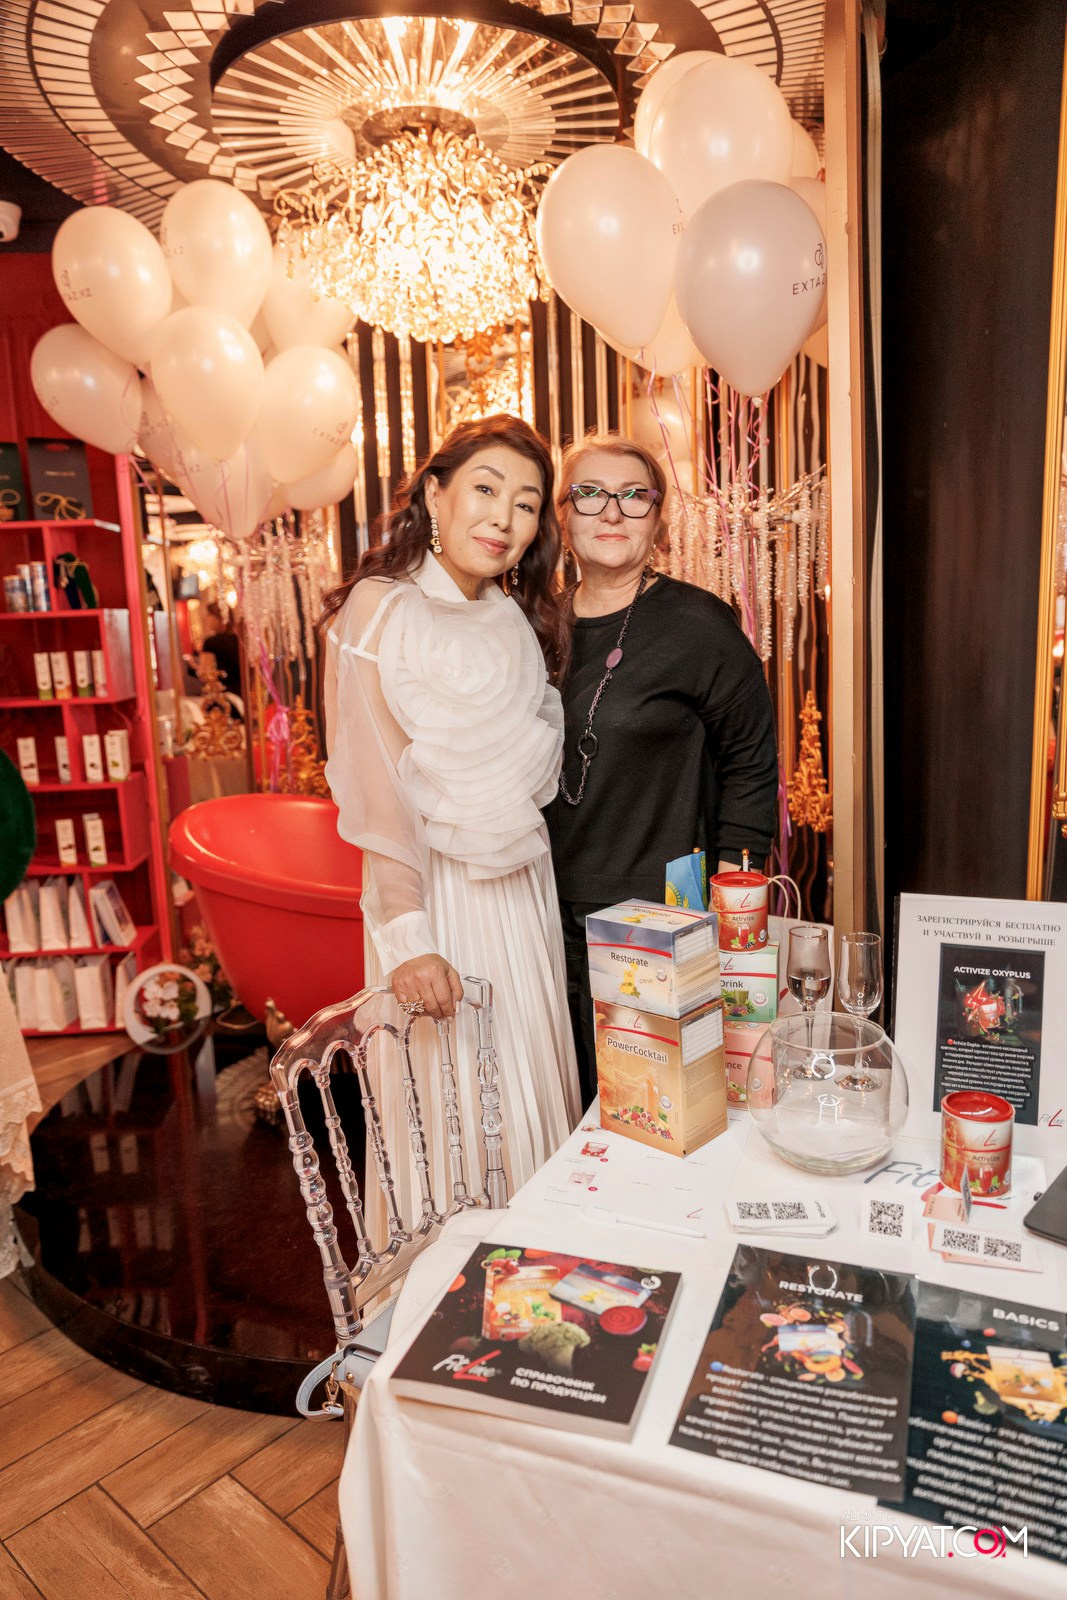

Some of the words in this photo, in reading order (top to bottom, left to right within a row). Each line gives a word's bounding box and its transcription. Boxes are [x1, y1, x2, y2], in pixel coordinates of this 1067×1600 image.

[917, 914, 1001, 928] ЗАРЕГИСТРИРУЙСЯ
[1005, 921, 1061, 932] БЕСПЛАТНО
[933, 929, 981, 940] УЧАСТВУЙ
[998, 935, 1056, 946] РОЗЫГРЫШЕ
[610, 951, 649, 968] Restorate
[953, 965, 991, 976] ACTIVIZE
[992, 968, 1031, 979] OXYPLUS
[606, 1037, 667, 1063] PowerCocktail
[778, 1280, 864, 1304] RESTORATE
[992, 1308, 1060, 1332] BASICS
[510, 1376, 530, 1389] ПО
[530, 1378, 608, 1404] ПРОДУКЦИИ
[514, 1366, 596, 1392] СПРАВОЧНИК
